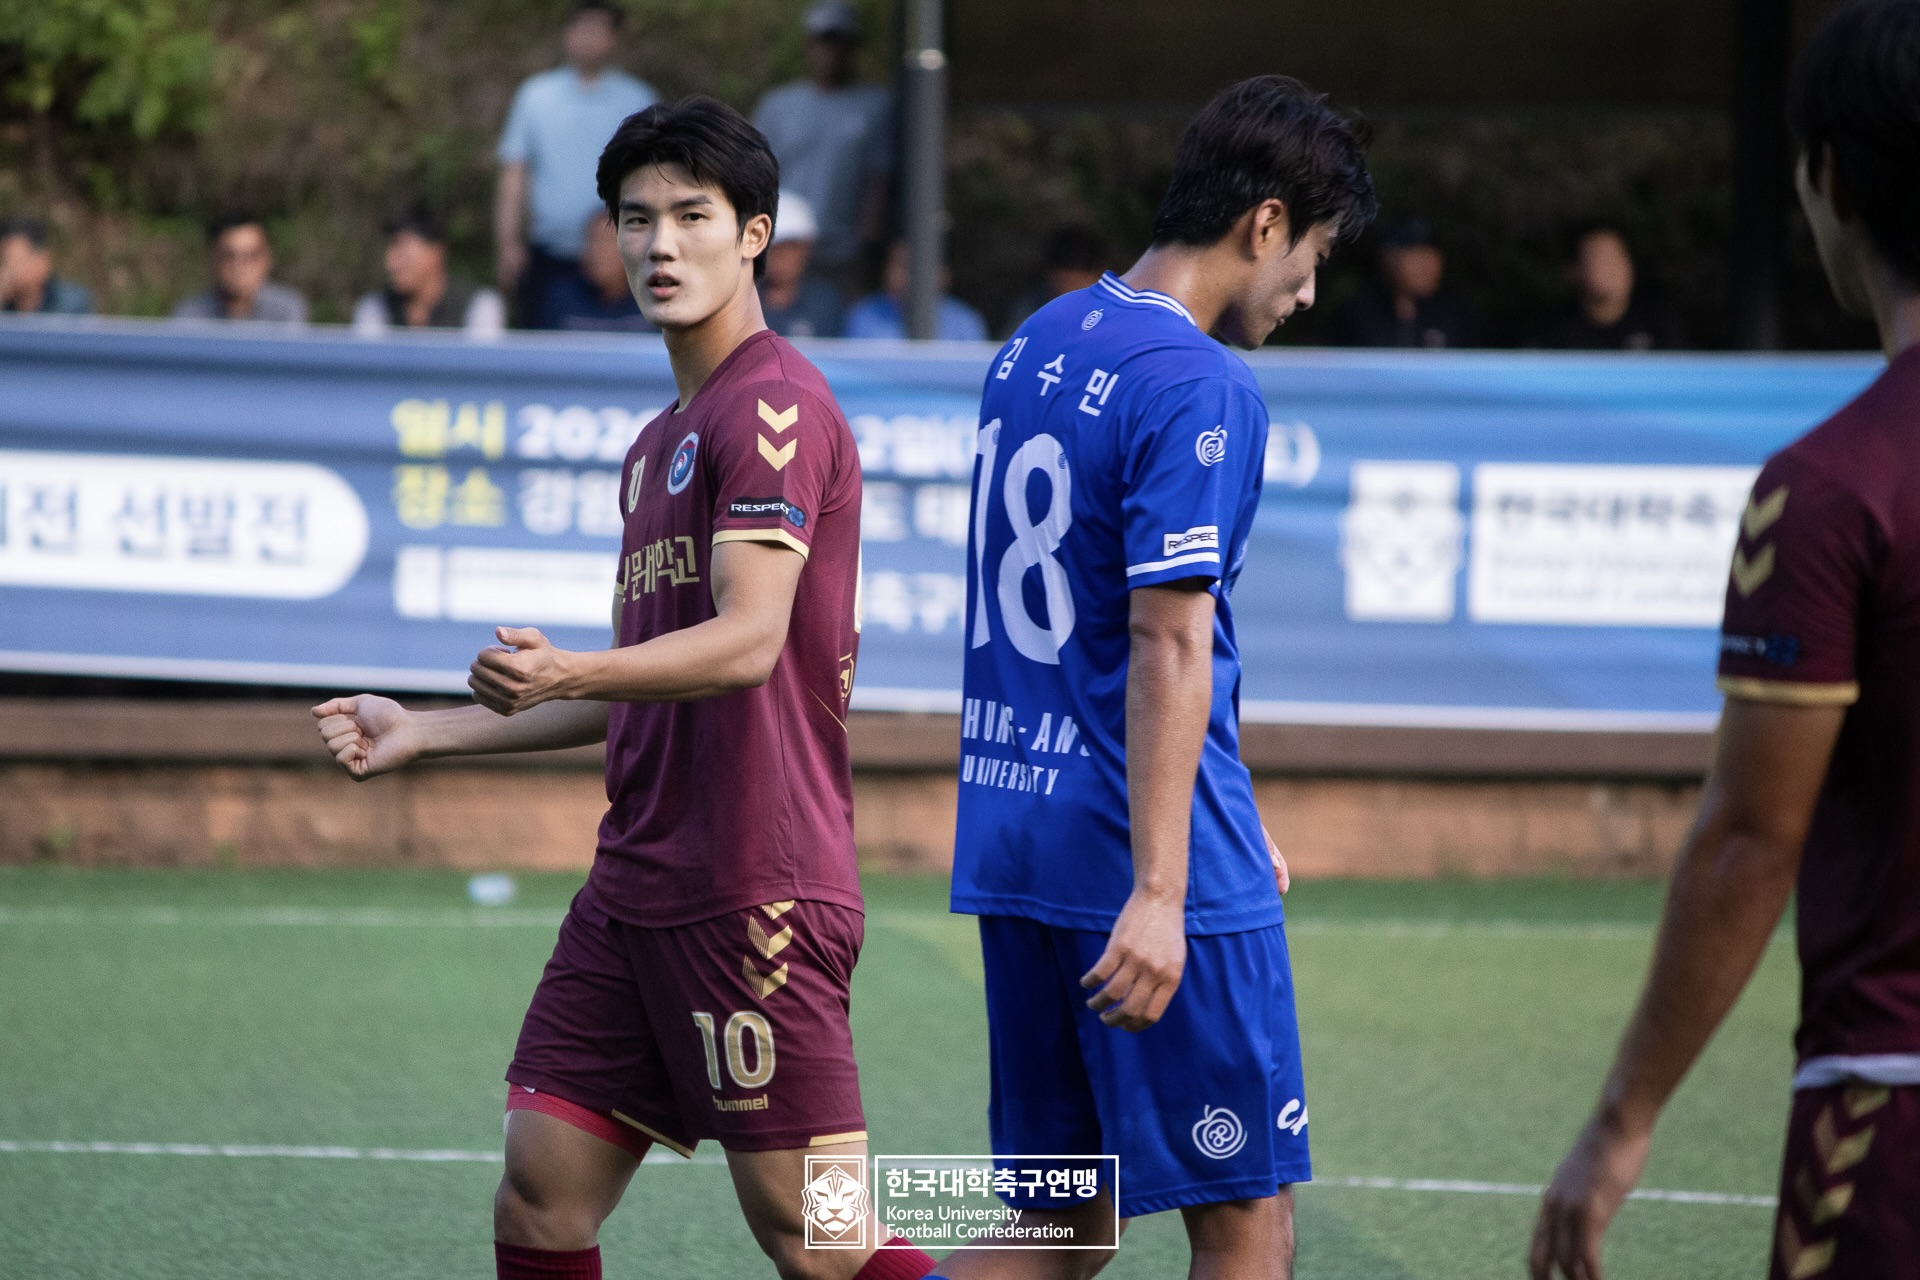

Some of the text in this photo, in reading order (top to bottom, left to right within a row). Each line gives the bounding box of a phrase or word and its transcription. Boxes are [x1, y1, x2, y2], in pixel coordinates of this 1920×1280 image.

[996, 337, 1120, 417] 김수민
[967, 418, 1077, 665] 18
[962, 754, 1060, 796] UNIVERSITY
[691, 1010, 777, 1090] 10
[712, 1093, 769, 1112] hummel
